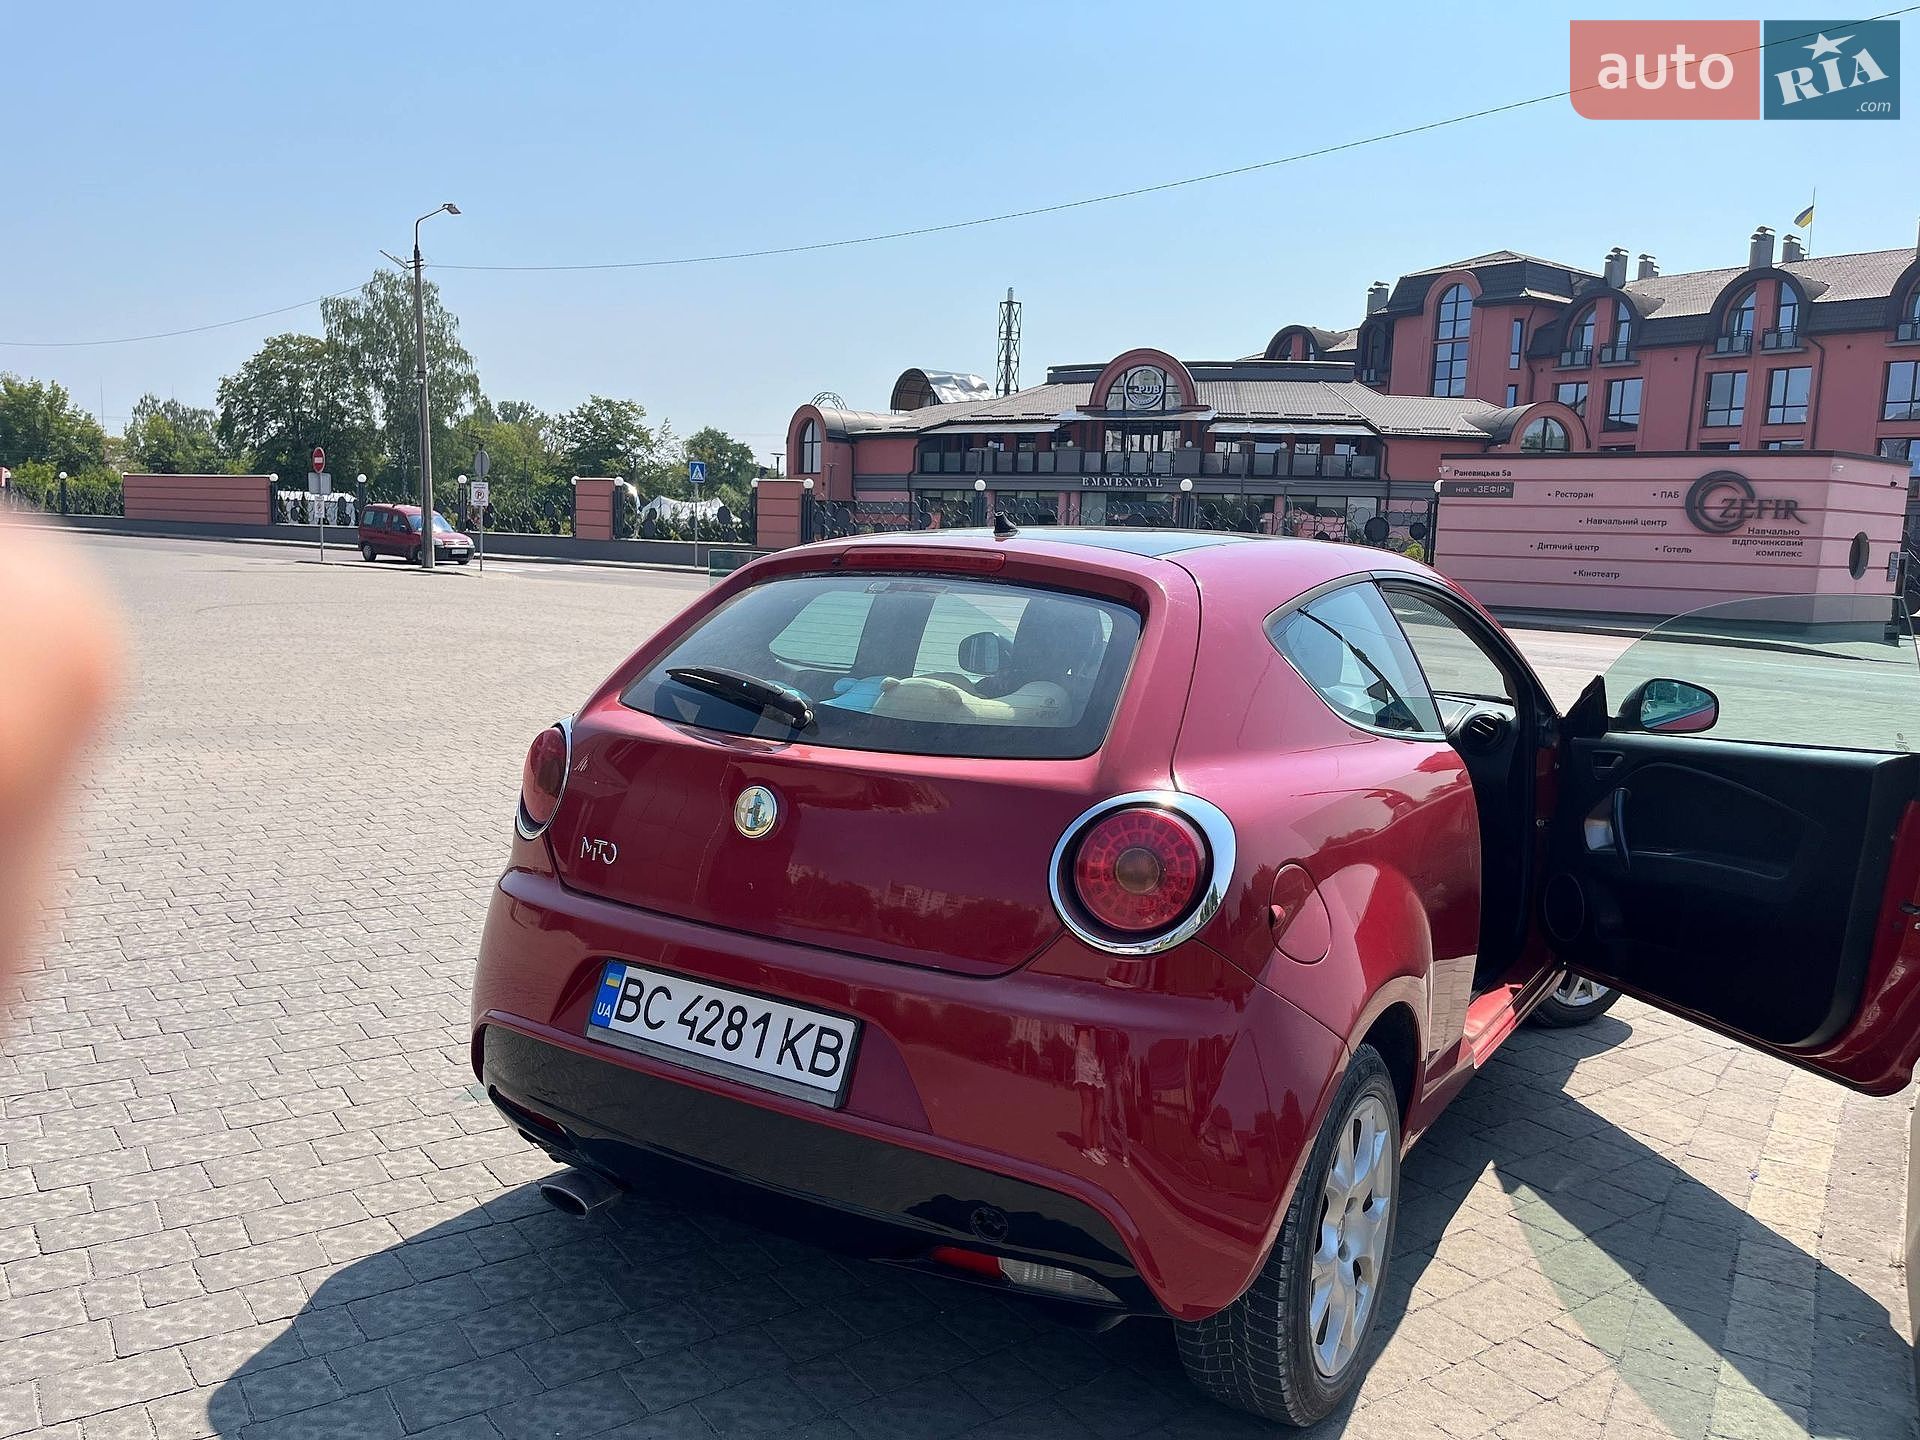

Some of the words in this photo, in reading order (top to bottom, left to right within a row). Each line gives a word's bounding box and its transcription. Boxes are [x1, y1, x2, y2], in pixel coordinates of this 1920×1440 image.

[1082, 477, 1163, 487] EMMENTAL
[1555, 490, 1594, 499] Ресторан
[1660, 490, 1680, 499] ПАБ
[1719, 498, 1808, 525] ZEFIR
[1586, 517, 1639, 526] Навчальний
[1640, 519, 1667, 528] центр
[1747, 527, 1800, 536] Навчально
[1731, 537, 1804, 547] відпочинковий
[1537, 542, 1573, 551] Дитячий
[1574, 544, 1600, 553] центр
[1662, 545, 1692, 554] Готель
[1755, 550, 1803, 558] комплекс
[1578, 569, 1620, 580] Кінотеатр
[596, 1002, 611, 1018] UA
[614, 977, 672, 1030] BC
[677, 995, 772, 1059] 4281
[776, 1018, 844, 1078] KB
